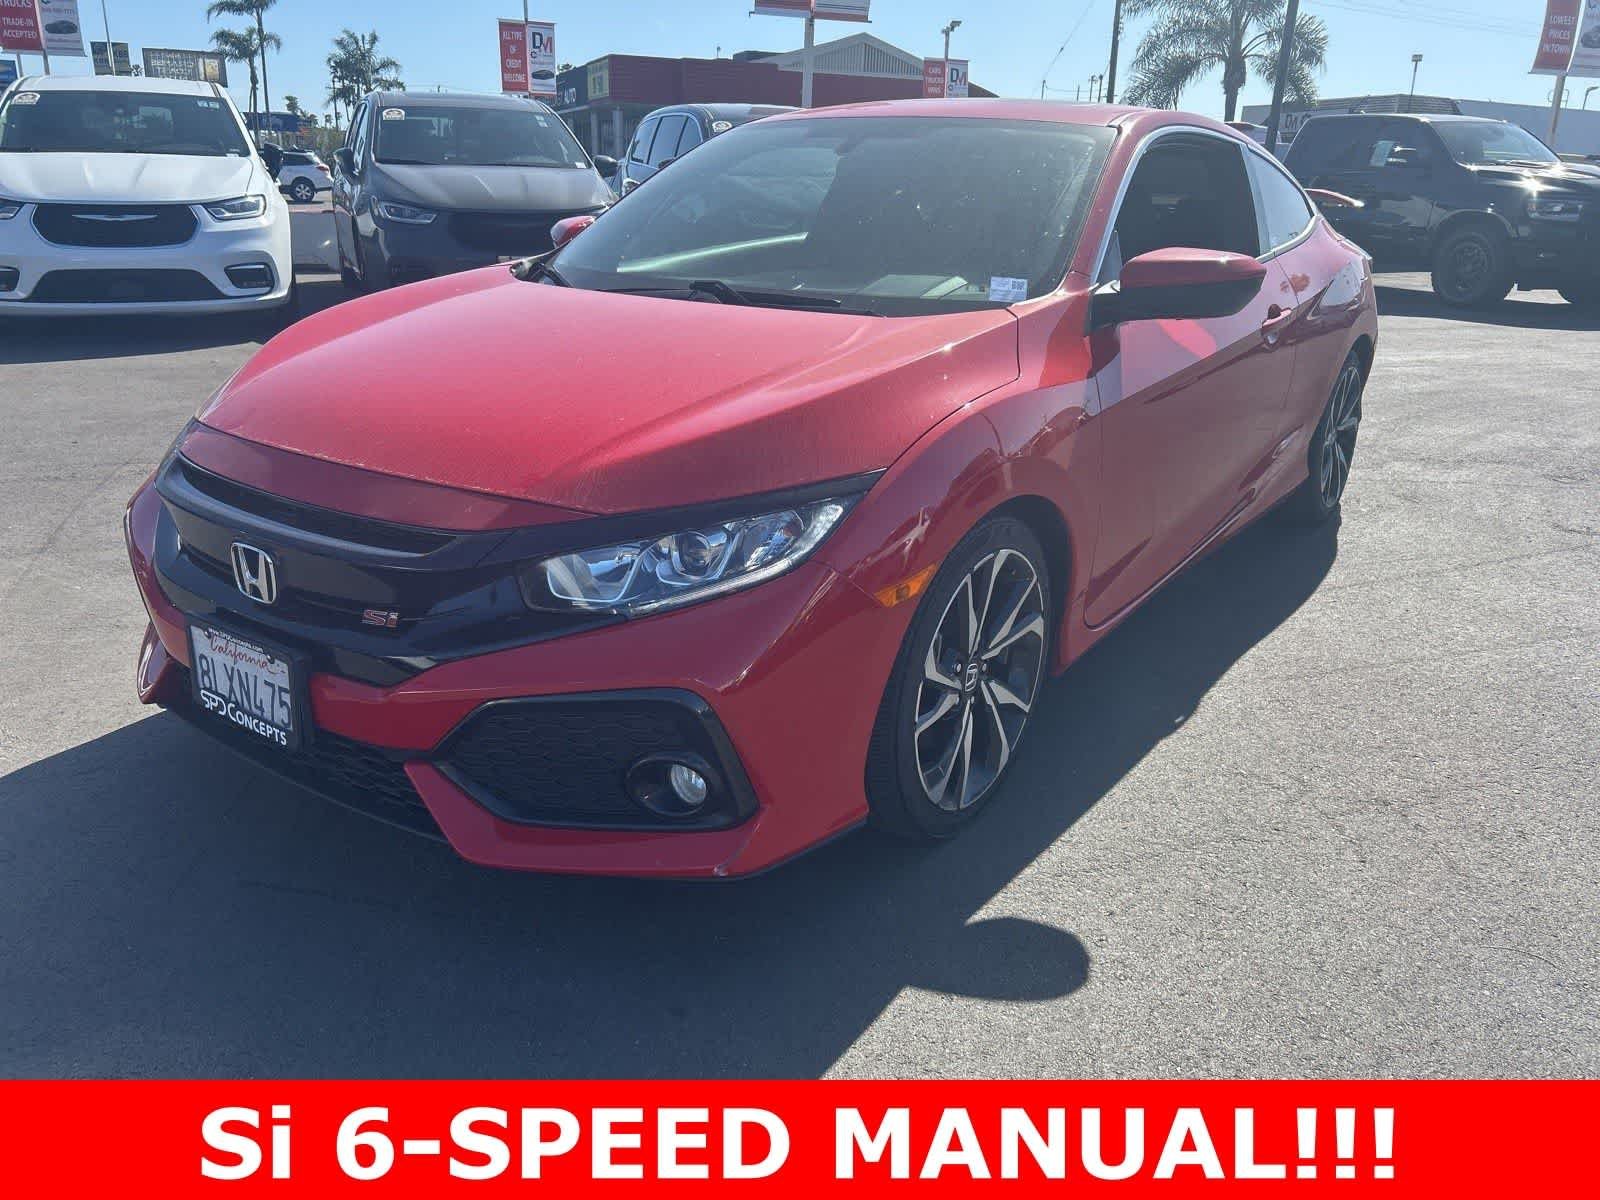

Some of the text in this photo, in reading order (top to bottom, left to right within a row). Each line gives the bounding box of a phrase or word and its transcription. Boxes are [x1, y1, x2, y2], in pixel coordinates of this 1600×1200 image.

[2, 17, 34, 27] TRADE-IN
[1550, 15, 1577, 25] LOWEST
[3, 30, 37, 39] ACCEPTED
[511, 31, 523, 41] TYPE
[1548, 30, 1570, 40] PRICES
[362, 609, 399, 628] Si
[210, 632, 268, 668] California
[199, 653, 293, 728] 8LXN475
[227, 702, 288, 746] CONCEPTS
